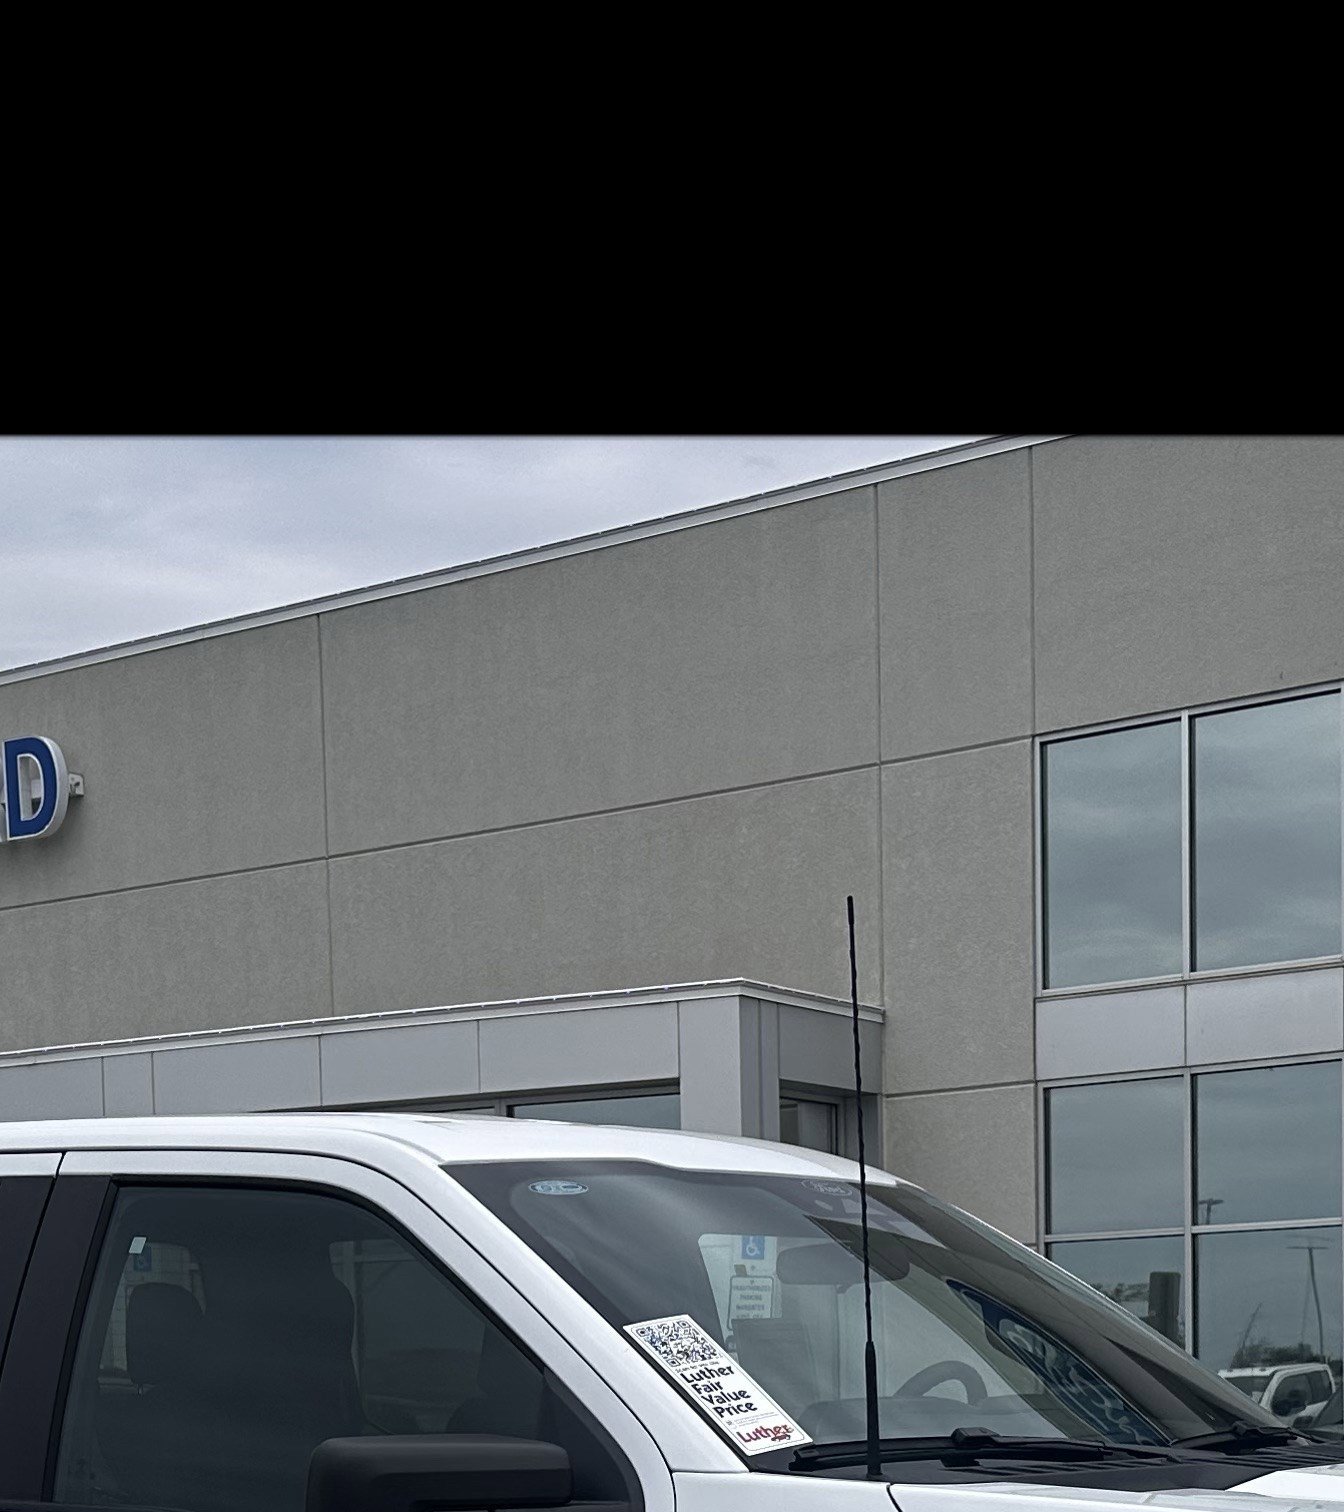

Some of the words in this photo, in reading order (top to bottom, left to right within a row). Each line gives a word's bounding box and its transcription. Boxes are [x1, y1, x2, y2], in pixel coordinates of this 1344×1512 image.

[680, 1366, 734, 1383] Luther
[691, 1380, 724, 1394] Fair
[701, 1389, 752, 1405] Value
[713, 1402, 758, 1418] Price
[736, 1424, 792, 1443] Luther
